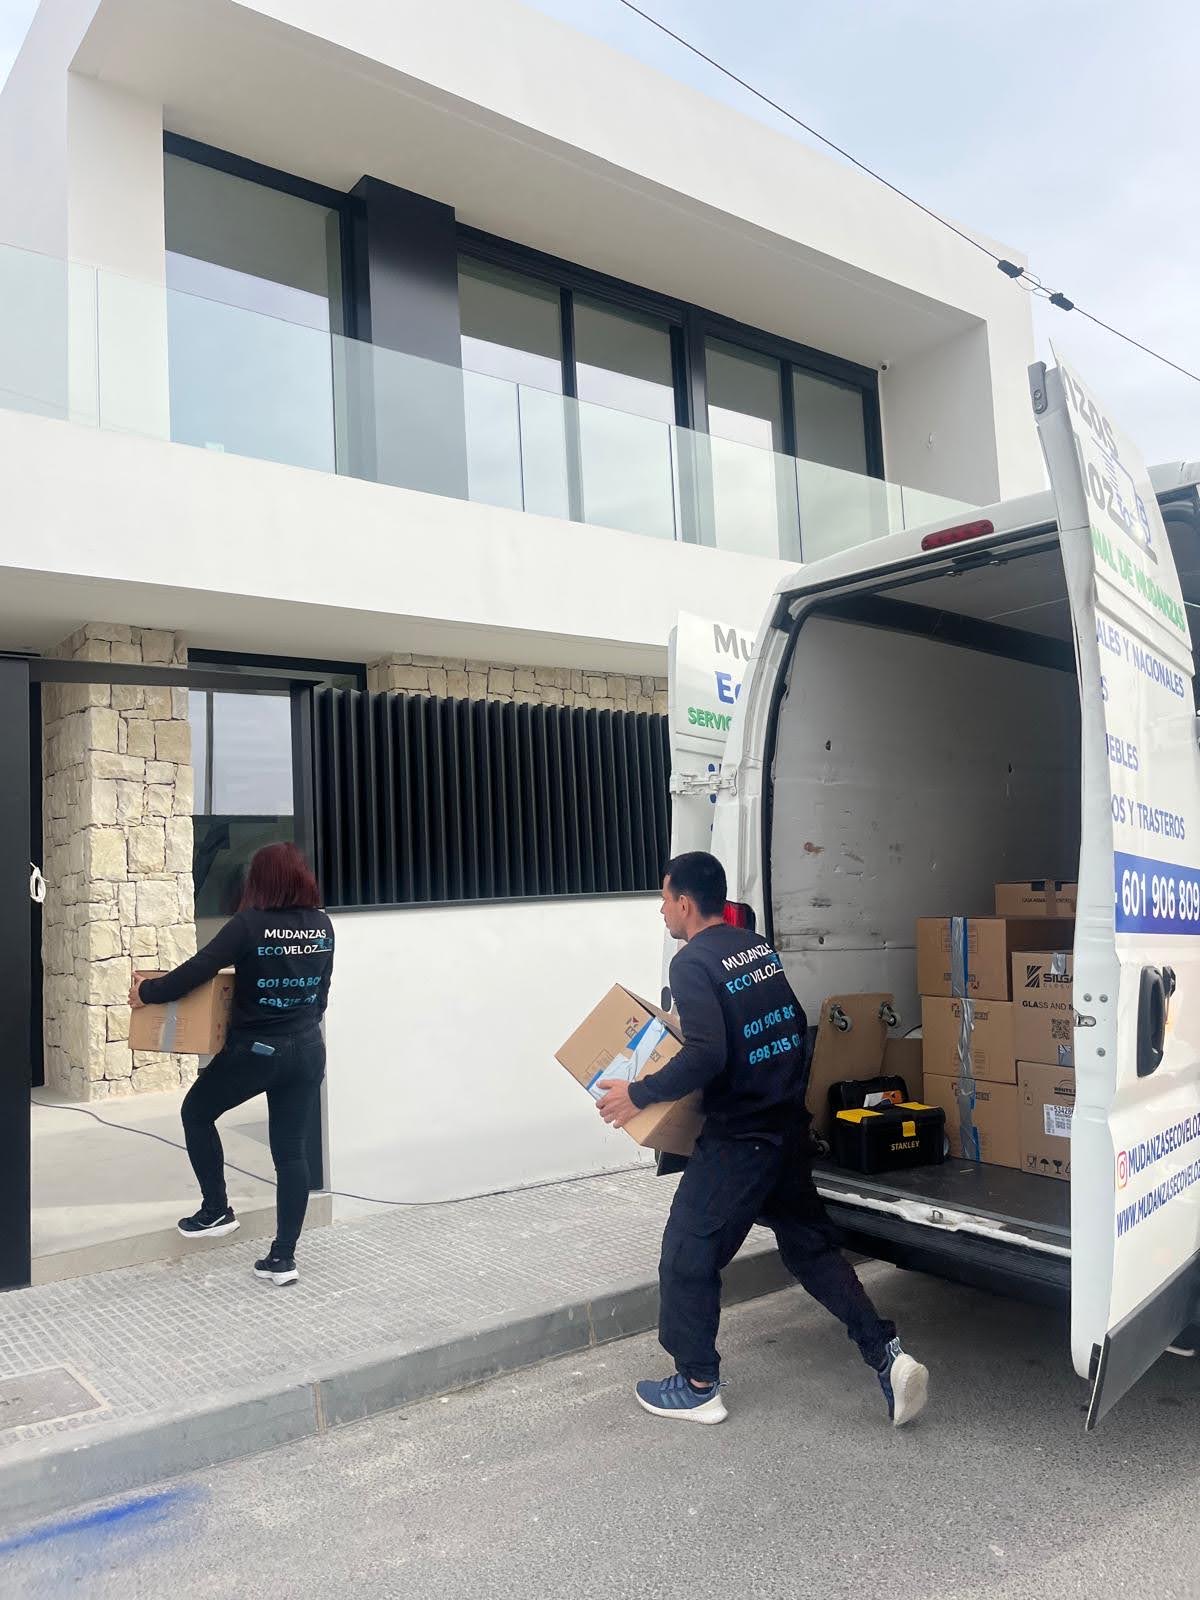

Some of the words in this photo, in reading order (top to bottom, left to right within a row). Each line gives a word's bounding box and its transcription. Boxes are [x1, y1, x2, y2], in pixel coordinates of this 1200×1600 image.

[1134, 564, 1186, 633] MUDANZAS
[1123, 637, 1129, 662] Y
[1132, 644, 1184, 698] NACIONALES
[1111, 794, 1126, 824] OS
[1127, 799, 1135, 826] Y
[1137, 803, 1186, 840] TRASTEROS
[1122, 870, 1146, 917] 601
[1152, 875, 1176, 919] 906
[1179, 880, 1200, 921] 809
[264, 928, 327, 940] MUDANZAS
[257, 944, 331, 956] ECOVELOZ
[257, 978, 280, 989] 601
[282, 978, 305, 988] 906
[725, 963, 783, 994] ECOVELOZ
[1022, 1000, 1048, 1009] GLASS
[1050, 1002, 1067, 1010] AND
[743, 1018, 763, 1039] 601
[764, 1009, 782, 1029] 906
[749, 1045, 771, 1065] 698
[770, 1037, 792, 1055] 215
[890, 1140, 920, 1151] STANLEY
